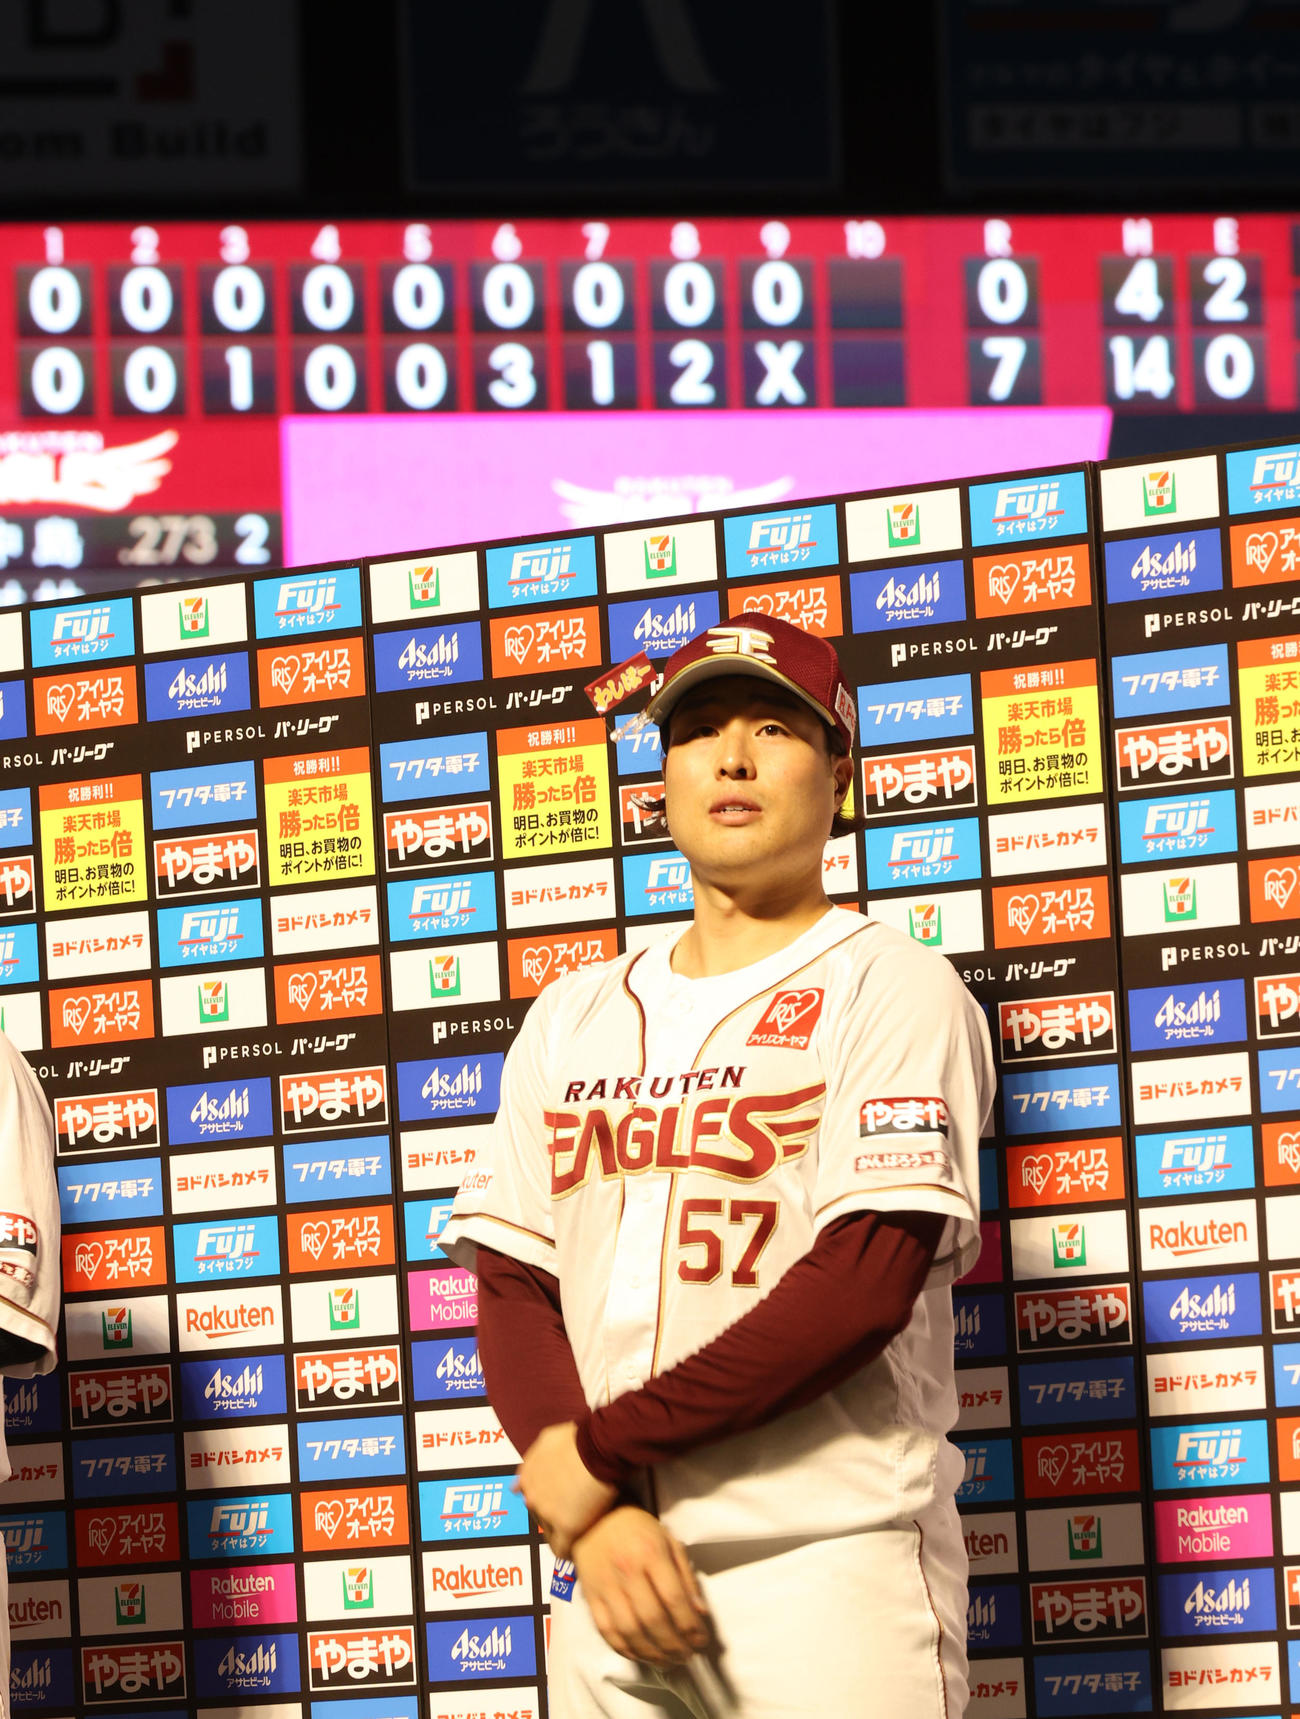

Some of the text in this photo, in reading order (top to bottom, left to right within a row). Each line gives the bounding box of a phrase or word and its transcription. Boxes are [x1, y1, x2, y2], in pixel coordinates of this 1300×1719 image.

[46, 228, 63, 265] 1
[132, 227, 158, 264] 2
[222, 226, 249, 263] 3
[312, 226, 340, 263] 4
[405, 224, 432, 262] 5
[492, 224, 522, 261] 6
[584, 223, 609, 260] 7
[671, 222, 700, 260] 8
[761, 222, 790, 259] 9
[984, 220, 1011, 257] R
[1123, 219, 1152, 256] H
[1214, 218, 1238, 256] E
[30, 257, 1248, 332] 0 0 0 0 0 0 0 0 0 0 4 2
[32, 334, 1254, 413] 0 0 1 0 0 3 1 2 X 7 14 0
[995, 482, 1060, 518] Fuji
[996, 515, 1058, 536] タイヤはフジ
[117, 515, 219, 566] .273
[235, 514, 271, 565] 2
[511, 545, 572, 581] Fuji
[1021, 556, 1075, 581] アイリス
[512, 578, 571, 598] タイヤはフジ
[876, 571, 940, 609] Asahi
[1023, 577, 1075, 602] オーヤマ
[52, 606, 110, 641] Fuji
[885, 605, 933, 620] アサヒビール
[1164, 608, 1232, 627] PERSOL
[54, 638, 109, 657] タイヤはフジ
[398, 632, 458, 669] Asahi
[911, 638, 977, 657] PERSOL
[168, 662, 226, 699] Asahi
[407, 665, 452, 680] アサヒビール
[1122, 665, 1220, 694] フクダ電子
[75, 676, 122, 700] アイリス
[76, 697, 122, 721] オーヤマ
[176, 695, 221, 710] アサヒビール
[434, 697, 496, 715] PERSOL
[867, 695, 964, 724] フクダ電子
[1007, 696, 1073, 721] 楽天市場
[204, 726, 265, 744] PERSOL
[997, 717, 1087, 755] 勝ったら倍
[1123, 726, 1227, 778] やまや
[389, 752, 480, 780] フクダ電子
[522, 755, 585, 778] 楽天市場
[513, 775, 597, 811] 勝ったら倍
[869, 755, 971, 806] やまや
[159, 781, 247, 808] フクダ電子
[63, 810, 122, 833] 楽天市場
[54, 829, 133, 864] 勝ったら倍
[391, 811, 488, 860] やまや
[996, 827, 1098, 852] ヨドバシカメラ
[160, 839, 254, 887] やまや
[511, 881, 607, 905] ヨドバシカメラ
[277, 908, 371, 932] ヨドバシカメラ
[52, 934, 143, 957] ヨドバシカメラ
[1181, 943, 1249, 961] PERSOL
[1155, 989, 1220, 1027] Asahi
[451, 1018, 514, 1034] PERSOL
[1164, 1024, 1214, 1039] アサヒビール
[221, 1043, 282, 1059] PERSOL
[564, 1066, 747, 1103] RAKUTEN
[1139, 1076, 1242, 1100] ヨドバシカメラ
[61, 1098, 154, 1144] やまや
[862, 1101, 947, 1132] やまや
[543, 1082, 827, 1201] EAGLES
[1161, 1135, 1227, 1171] Fuji
[1053, 1148, 1107, 1172] アイリス
[68, 1178, 154, 1202] フクダ電子
[1055, 1170, 1108, 1194] オーヤマ
[1162, 1169, 1225, 1187] タイヤはフジ
[196, 1224, 255, 1258] Fuji
[677, 1198, 781, 1288] 57
[1149, 1219, 1247, 1249] Rakuten
[198, 1256, 254, 1273] タイヤはフジ
[1169, 1282, 1235, 1319] Asahi
[185, 1304, 274, 1332] Rakuten
[1021, 1292, 1128, 1342] やまや
[1179, 1317, 1229, 1331] アサヒビール
[203, 1363, 264, 1399] Asahi
[1029, 1377, 1126, 1402] フクダ電子
[212, 1398, 259, 1412] アサヒビール
[190, 1446, 282, 1466] ヨドバシカメラ
[306, 1435, 396, 1460] フクダ電子
[1176, 1429, 1241, 1464] Fuji
[1178, 1463, 1239, 1479] タイヤはフジ
[345, 1495, 393, 1518] アイリス
[443, 1482, 506, 1517] Fuji
[210, 1501, 270, 1536] Fuji
[346, 1517, 393, 1539] オーヤマ
[444, 1516, 503, 1533] タイヤはフジ
[1175, 1502, 1248, 1529] Rakuten
[211, 1534, 269, 1552] タイヤはフジ
[1177, 1531, 1231, 1554] Mobile
[208, 1571, 275, 1596] Rakuten
[431, 1564, 522, 1591] Rakuten
[209, 1598, 259, 1620] Mobile
[451, 1625, 512, 1660] Asahi
[315, 1634, 411, 1680] やまや
[460, 1659, 506, 1672] アサヒビール
[87, 1650, 182, 1695] やまや
[1169, 1665, 1272, 1686] ヨドバシカメラ
